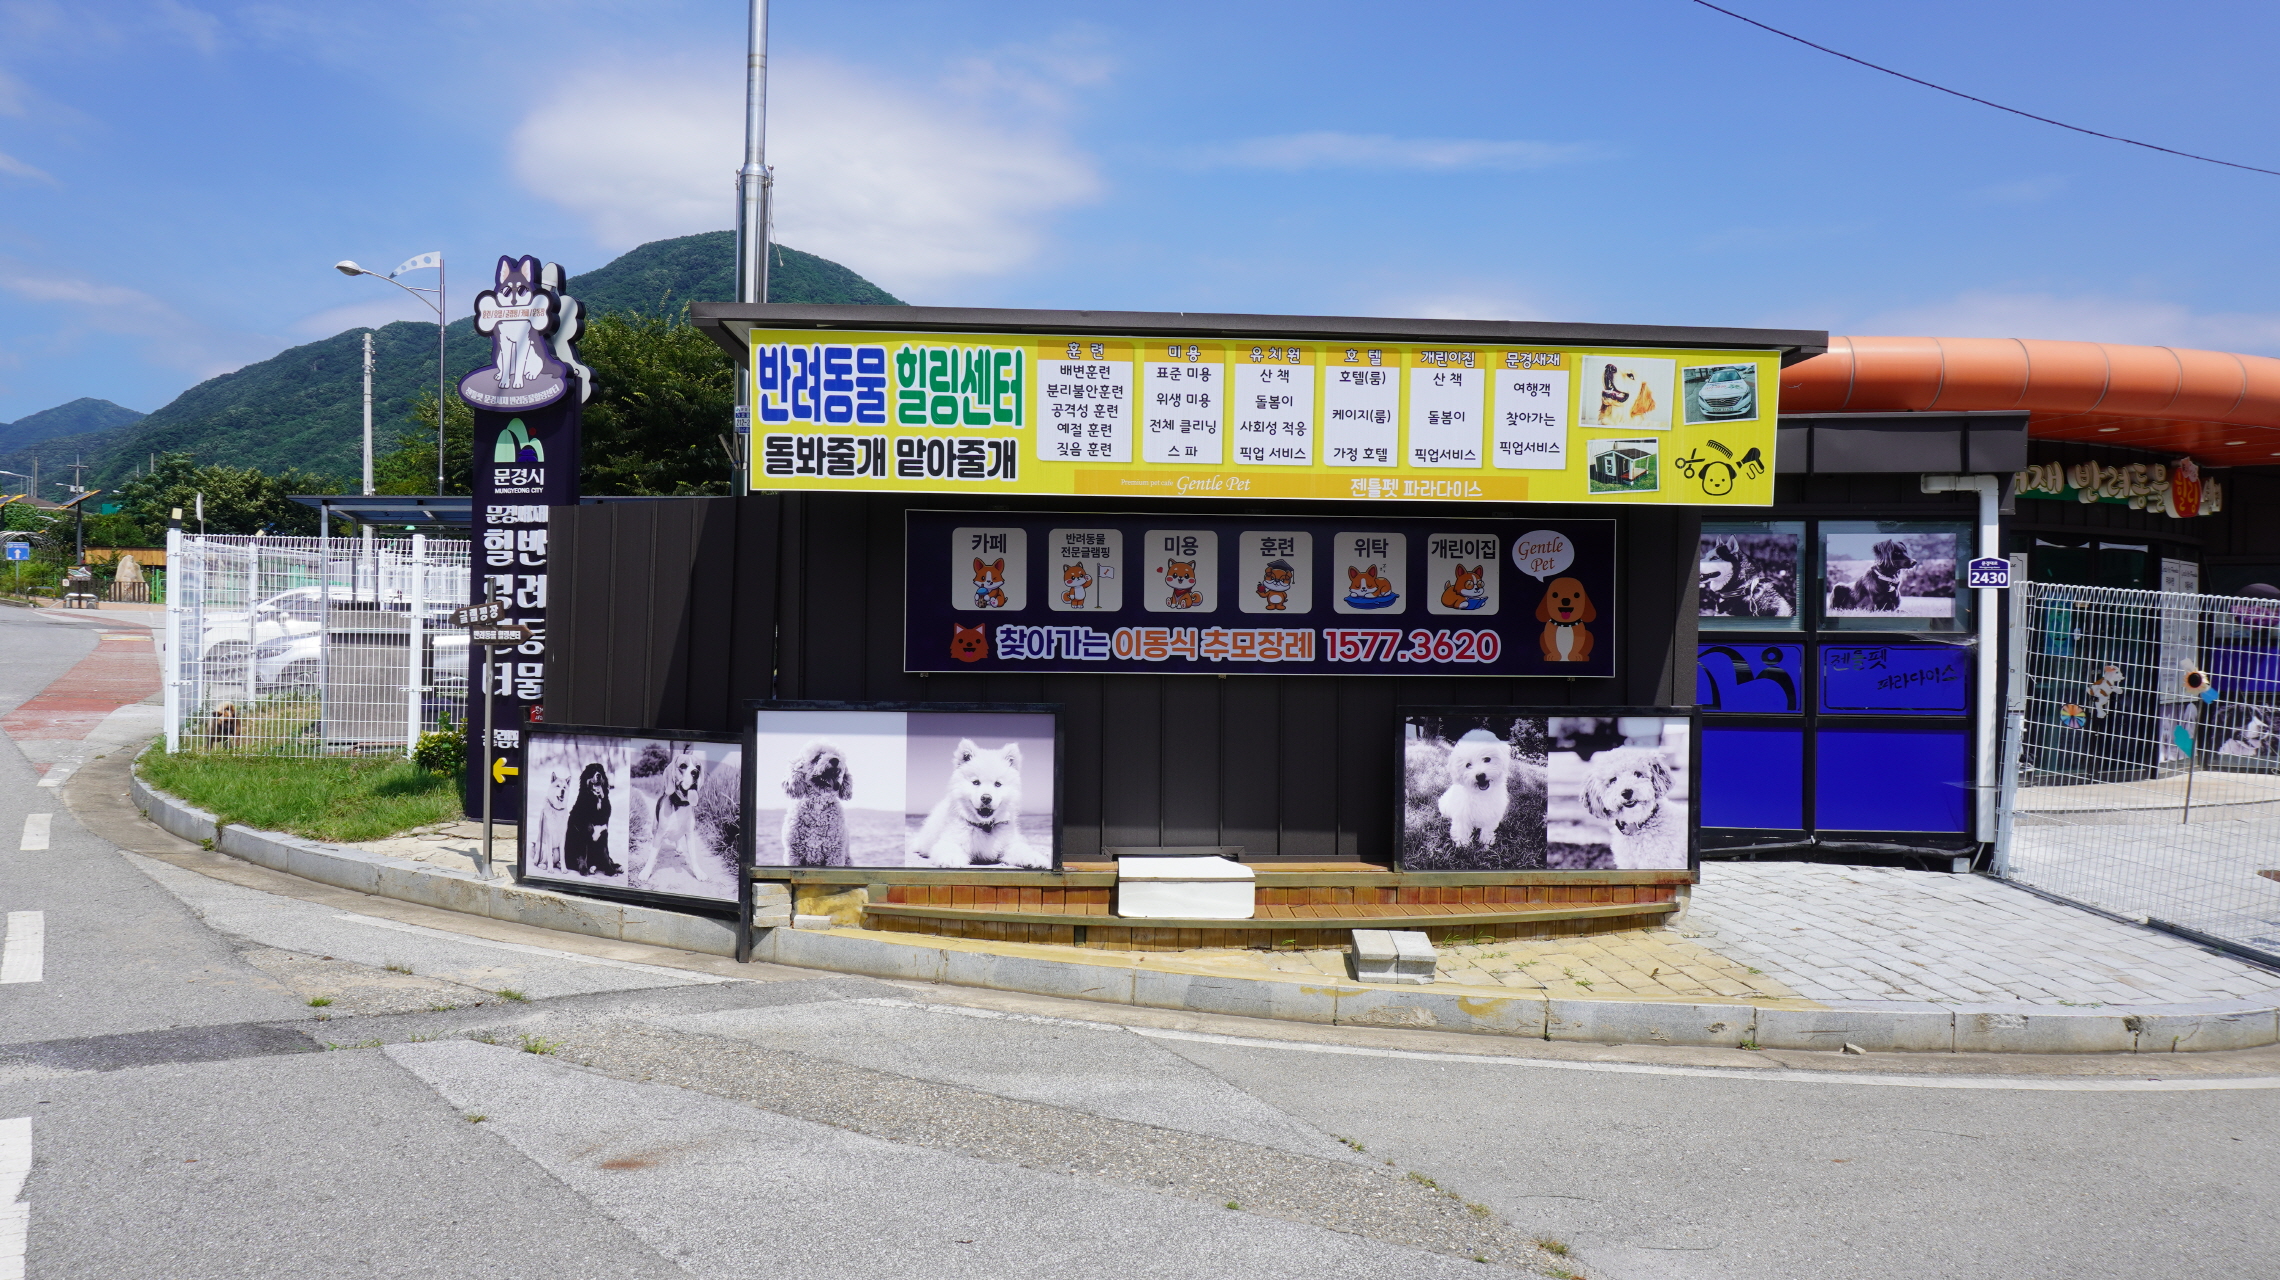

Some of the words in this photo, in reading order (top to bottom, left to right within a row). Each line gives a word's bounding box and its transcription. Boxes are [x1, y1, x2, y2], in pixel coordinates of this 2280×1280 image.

[1421, 351, 1475, 367] 개린이집
[1505, 352, 1561, 369] 문경새재
[1060, 365, 1111, 379] 배변훈련
[1156, 367, 1182, 381] 표준
[1187, 367, 1212, 382] 미용
[1339, 370, 1386, 386] 호텔(룸)
[759, 345, 886, 425] 반려동물
[896, 346, 1023, 427] 힐링센터
[1047, 384, 1123, 399] 분리불안훈련
[1513, 383, 1551, 397] 여행객
[1156, 393, 1182, 407] 위생
[1186, 393, 1211, 408] 미용
[1255, 394, 1293, 410] 돌봄이
[1051, 403, 1088, 418] 공격성
[1093, 403, 1118, 418] 훈련
[1332, 409, 1391, 424] 케이지(룸)
[1428, 410, 1465, 425] 돌봄이
[1150, 419, 1174, 433] 전체
[1179, 419, 1217, 434] 클리닝
[1506, 412, 1556, 426] 찾아가는
[1057, 423, 1082, 437] 예절
[1087, 423, 1112, 438] 훈련
[1240, 420, 1277, 435] 사회성
[1282, 421, 1307, 437] 적응
[1057, 442, 1082, 457] 짖음
[1087, 442, 1112, 457] 훈련
[1240, 447, 1264, 461] 픽업
[1269, 448, 1307, 459] 서비스
[1333, 447, 1358, 461] 가정
[1362, 448, 1388, 462] 호텔
[1415, 449, 1476, 462] 픽업서비스
[1499, 441, 1560, 456] 픽업서비스
[765, 436, 886, 477] 돌봐줄개
[897, 437, 1016, 479] 맡아줄개
[494, 468, 545, 486] 문경시
[1150, 479, 1160, 487] pet
[1177, 474, 1223, 495] Gentle
[1226, 476, 1251, 491] Pet
[1350, 478, 1399, 498] 젠틀펫
[1403, 480, 1483, 498] 파라다이스
[2076, 460, 2169, 512] 반려동물
[485, 505, 549, 524] 문경새재
[971, 533, 1007, 554] 카페
[1065, 533, 1106, 545] 반려동물
[1165, 536, 1199, 557] 미용
[1061, 546, 1110, 559] 전문글램핑
[1259, 537, 1295, 558] 훈련
[1354, 538, 1389, 558] 위탁
[1431, 539, 1496, 560] 개린이집
[1517, 536, 1564, 562] Gentle
[1530, 556, 1556, 573] Pet
[1971, 572, 2007, 584] 2430
[514, 529, 548, 700] 반려동물
[999, 626, 1108, 659] 찾아가는
[1116, 628, 1196, 659] 이동식
[1203, 629, 1314, 660] 추모장례
[1325, 631, 1499, 661] 1577.3620
[1830, 648, 1887, 671] 젠틀펫
[1877, 664, 1958, 690] 파라다이스
